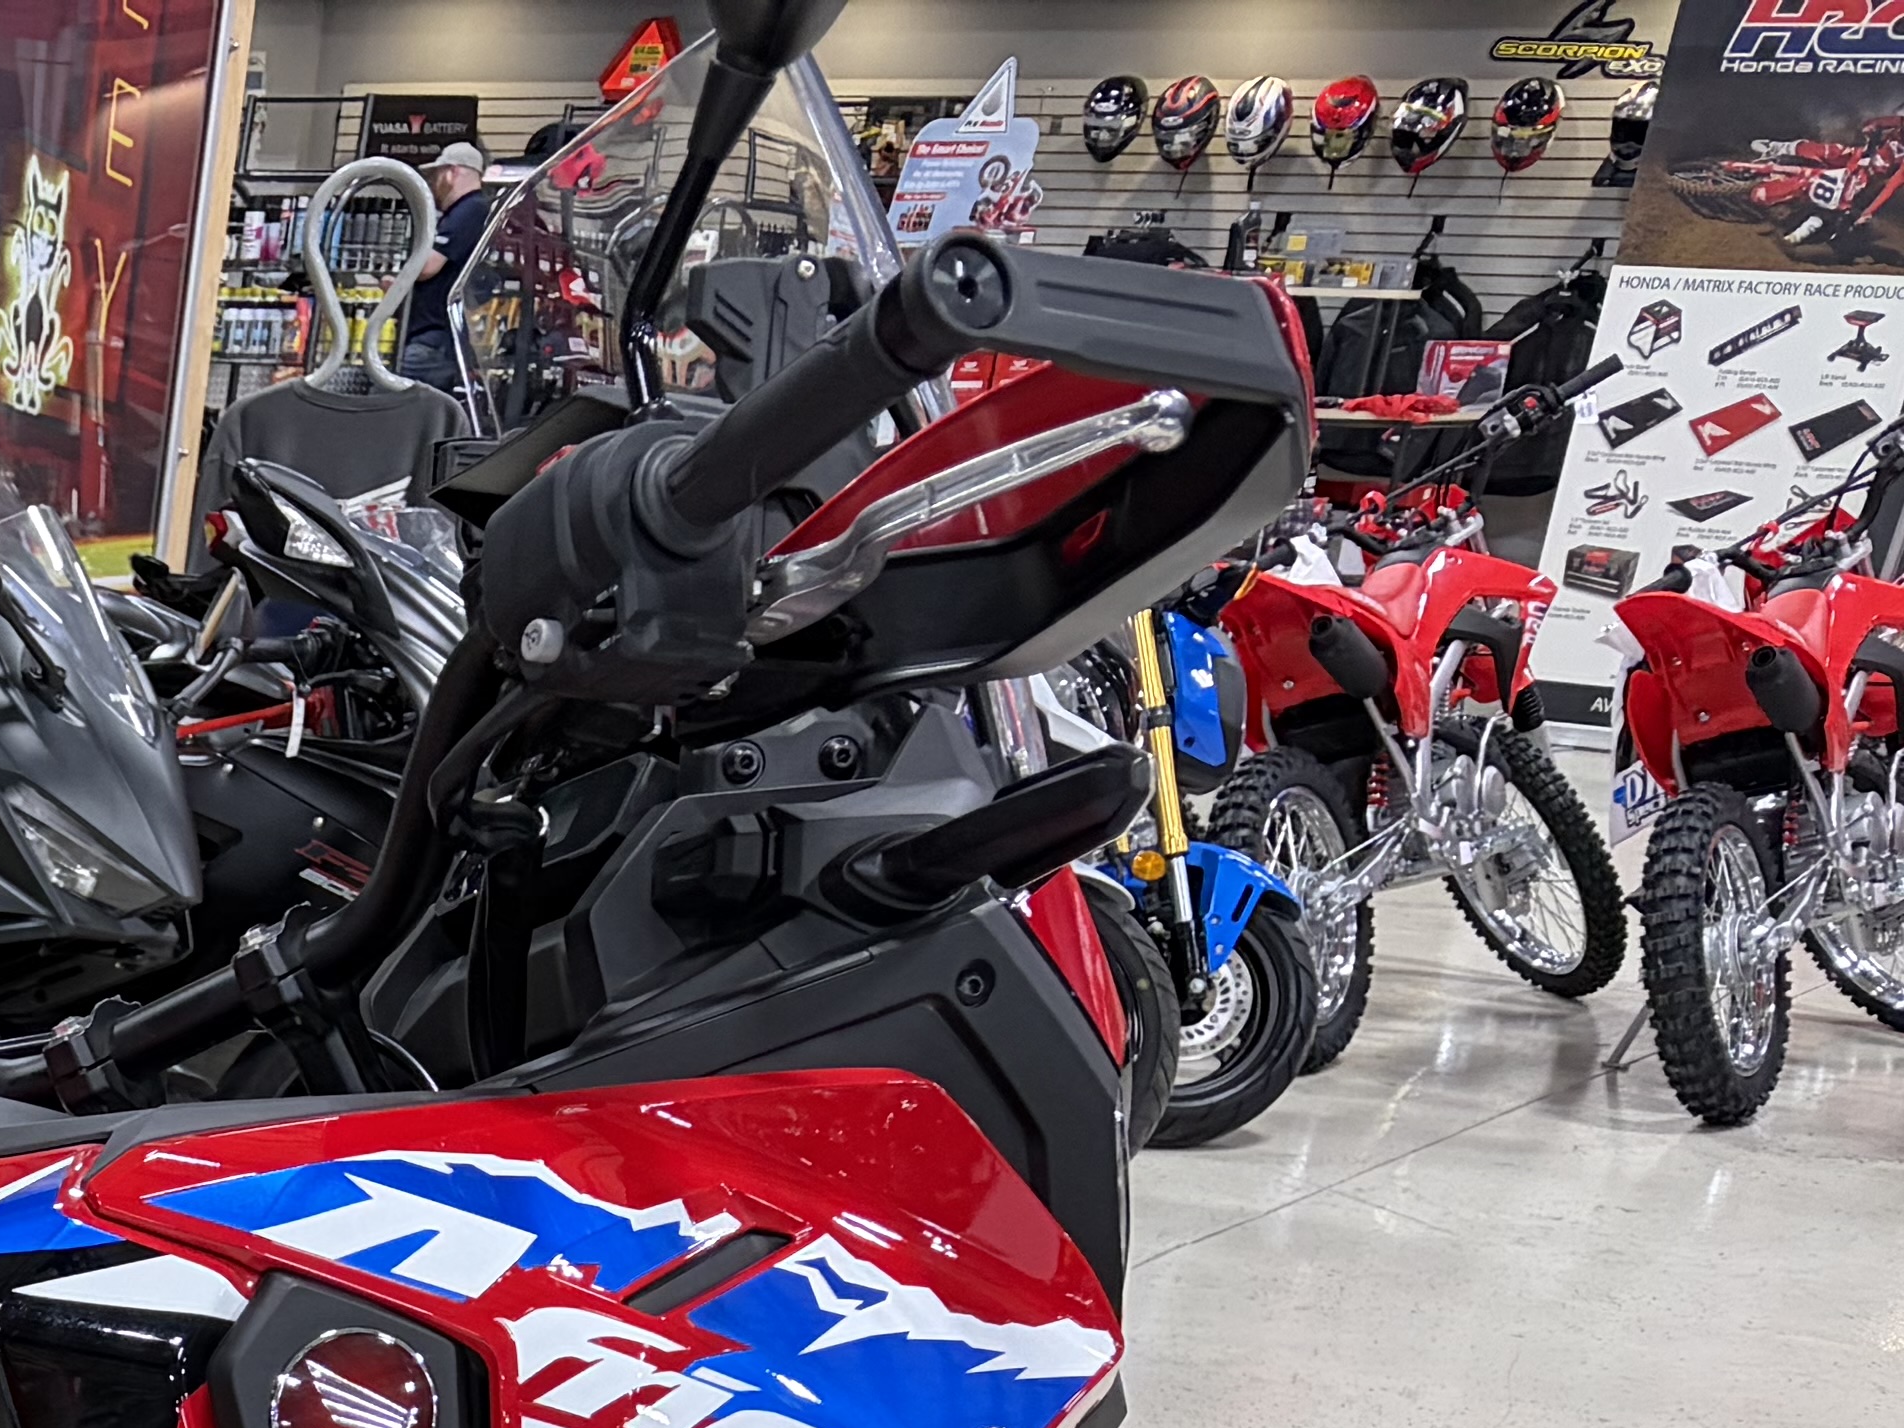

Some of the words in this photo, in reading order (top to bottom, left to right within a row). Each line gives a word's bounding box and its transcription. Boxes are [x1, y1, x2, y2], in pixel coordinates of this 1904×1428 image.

[1497, 42, 1647, 59] SCORPION
[1608, 60, 1663, 73] EXO
[1721, 59, 1812, 73] Honda
[1818, 59, 1904, 74] RACIN
[373, 122, 409, 134] YUASA
[423, 122, 468, 134] BATTERY
[1619, 276, 1671, 291] HONDA
[1682, 277, 1735, 294] MATRIX
[1735, 280, 1802, 296] FACTORY
[1803, 283, 1841, 298] RACE
